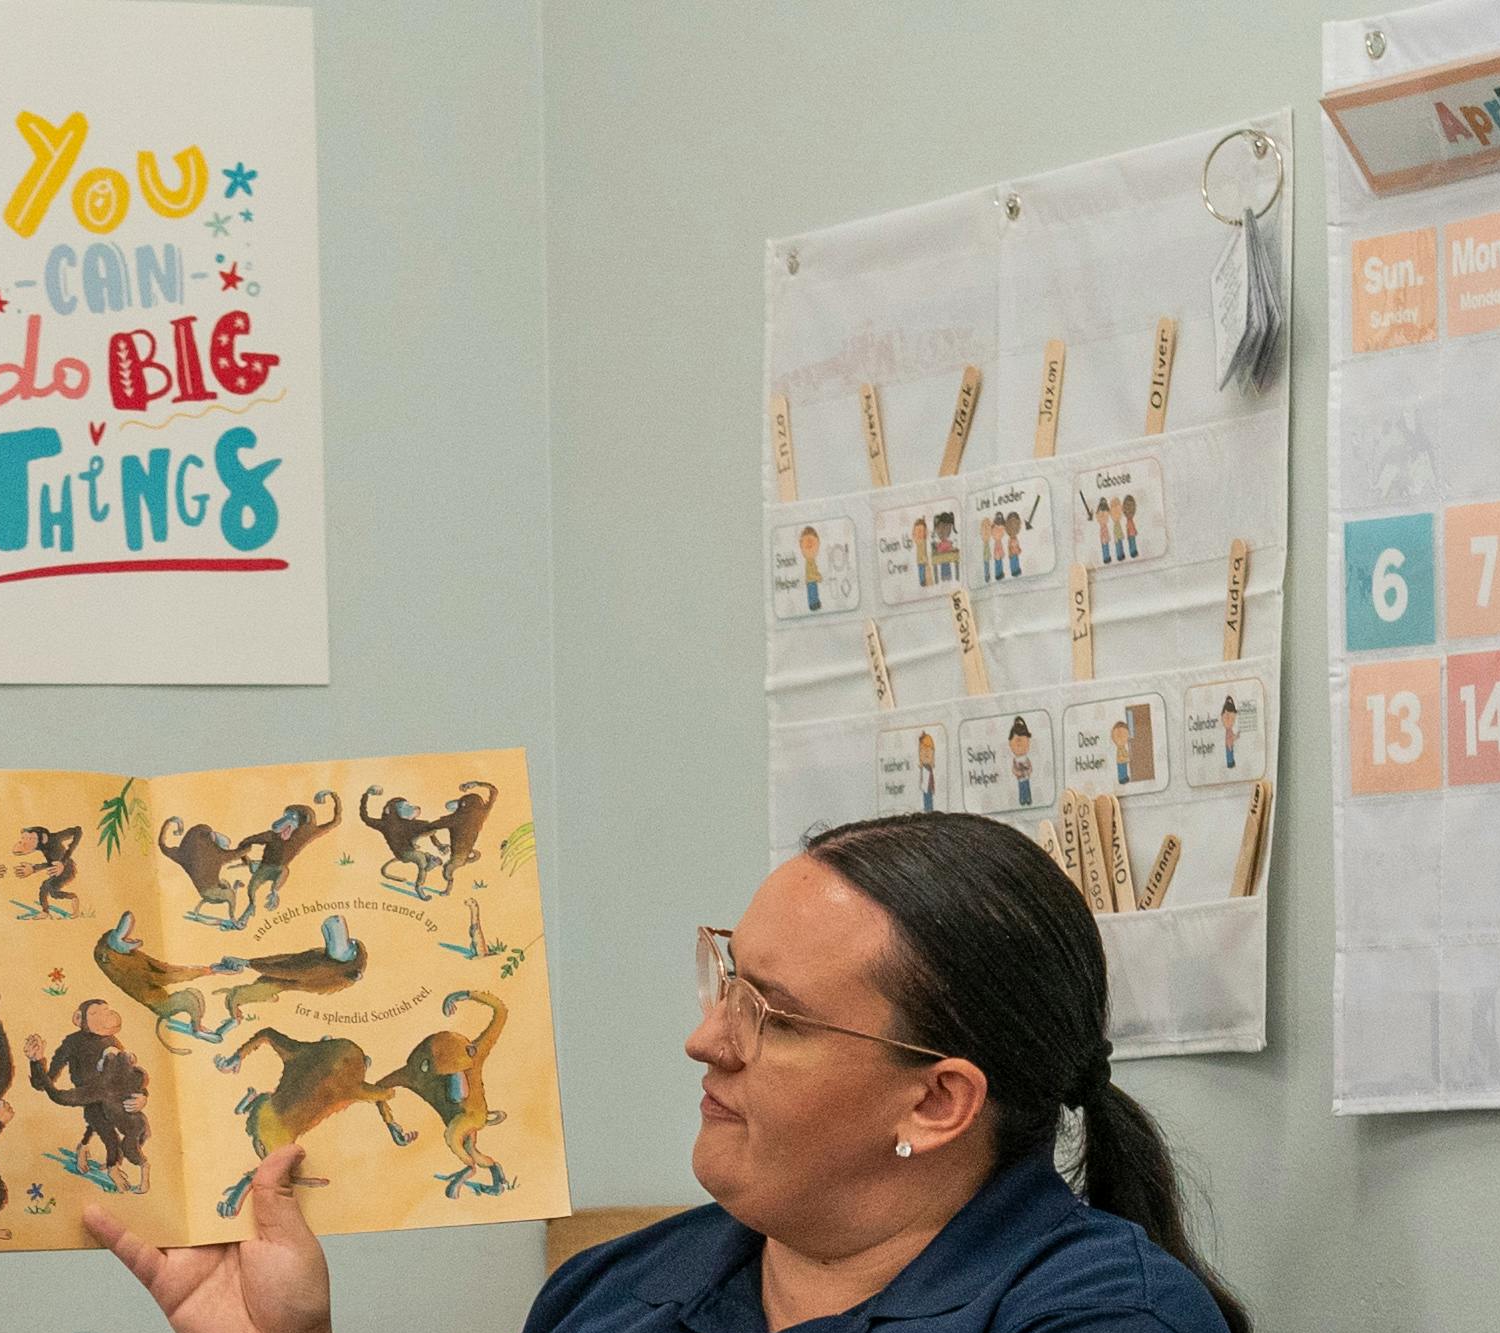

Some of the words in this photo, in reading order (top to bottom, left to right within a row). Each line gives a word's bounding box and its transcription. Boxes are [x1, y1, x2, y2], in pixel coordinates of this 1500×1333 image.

[44, 243, 185, 315] CAN
[1364, 256, 1424, 295] Sun.
[1370, 306, 1419, 330] Sunday
[108, 311, 280, 412] BIG
[1040, 360, 1058, 422] Jaxon
[1151, 329, 1168, 410] Oliver
[954, 384, 973, 437] Jack
[1096, 472, 1132, 490] Caboose
[1227, 556, 1243, 631] Audra
[1372, 549, 1408, 622] 6
[1471, 536, 1498, 608] 7
[1073, 590, 1088, 641] Eva
[1078, 731, 1100, 748] Door
[1366, 691, 1423, 766] 13
[1063, 802, 1077, 869] Mars
[1078, 804, 1104, 910] Santiago
[253, 919, 272, 942] and
[272, 907, 300, 925] eight
[302, 899, 350, 915] baboons
[353, 896, 378, 910] then
[382, 902, 425, 922] teamed
[425, 918, 439, 934] up
[295, 1003, 311, 1016] for
[314, 1011, 320, 1020] a
[322, 1010, 369, 1025] splendid
[371, 1000, 412, 1020] Scottish
